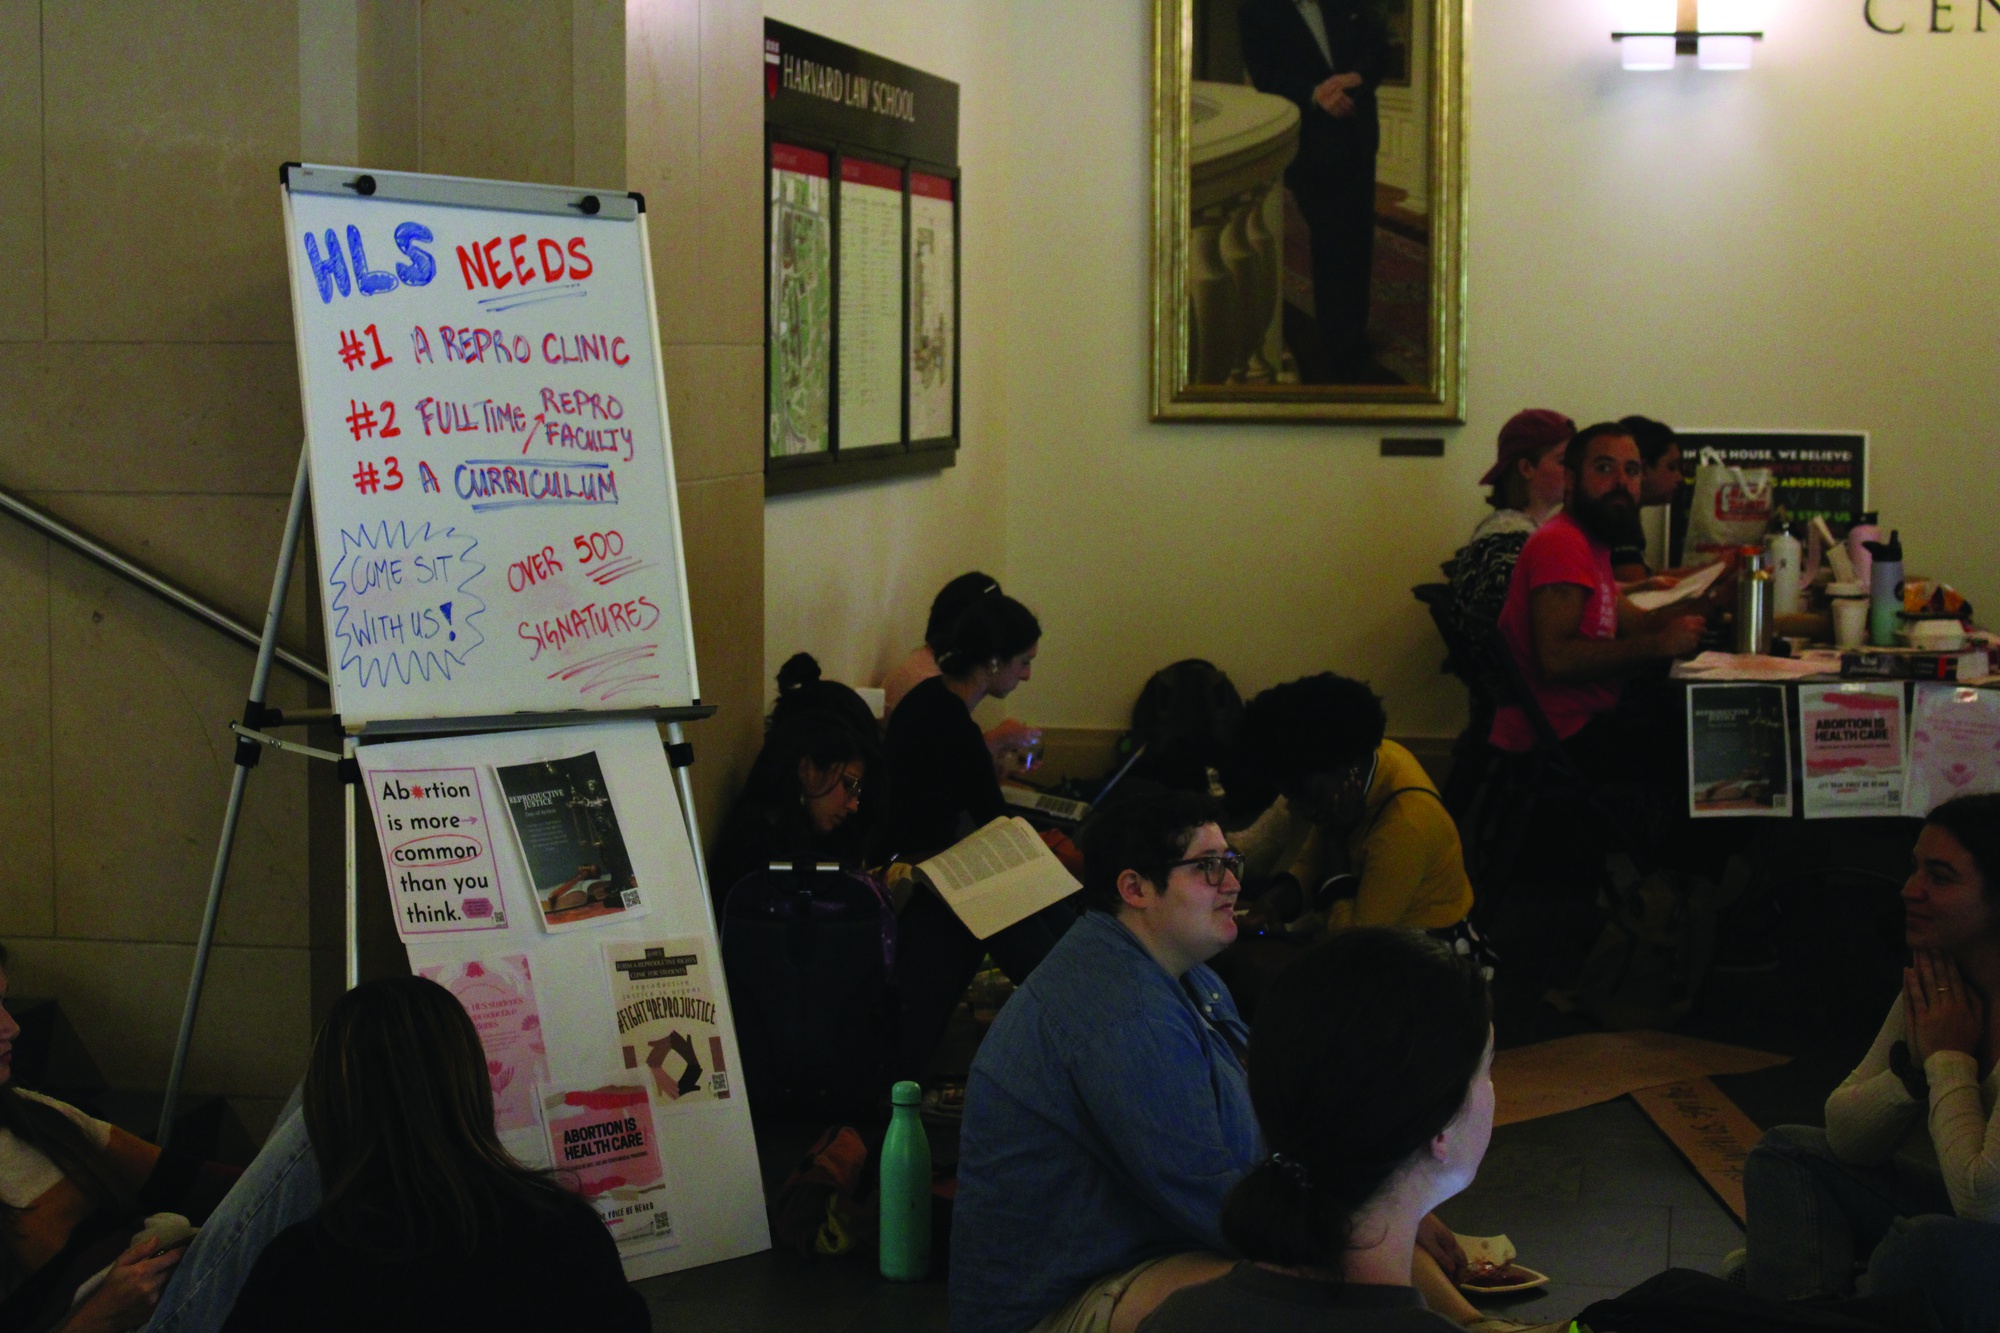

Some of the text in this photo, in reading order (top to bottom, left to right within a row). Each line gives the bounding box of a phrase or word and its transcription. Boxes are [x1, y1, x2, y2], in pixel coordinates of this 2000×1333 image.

[783, 52, 916, 123] HARVARD LAW SCHOOL
[304, 221, 594, 304] HLS NEEDS
[337, 323, 631, 372] #1 A REPRO CLINIC
[539, 386, 624, 421] REPRO
[344, 399, 402, 442] #2
[544, 422, 635, 462] FACULTY
[1778, 449, 1798, 461] WE
[352, 456, 620, 503] #3 A CURRICULUM
[1781, 476, 1853, 490] ABORTIONS
[349, 554, 454, 596] COME SIT
[508, 529, 624, 593] OVER 500
[350, 613, 404, 648] WITH
[517, 595, 661, 663] SIGNATURES
[1815, 728, 1888, 742] HEALTH CARE
[1816, 717, 1886, 730] ABORTION IS
[508, 788, 565, 804] REPRODUCTIVE
[522, 797, 553, 811] JUSTICE
[387, 814, 461, 831] is more
[394, 843, 478, 862] common
[400, 871, 489, 895] than you
[406, 901, 462, 924] think.
[564, 1117, 637, 1145] ABORTION IS
[564, 1132, 644, 1161] HEALTH CARE
[607, 1207, 624, 1219] VOICE
[625, 1205, 633, 1215] BE
[634, 1202, 654, 1213] HEARD
